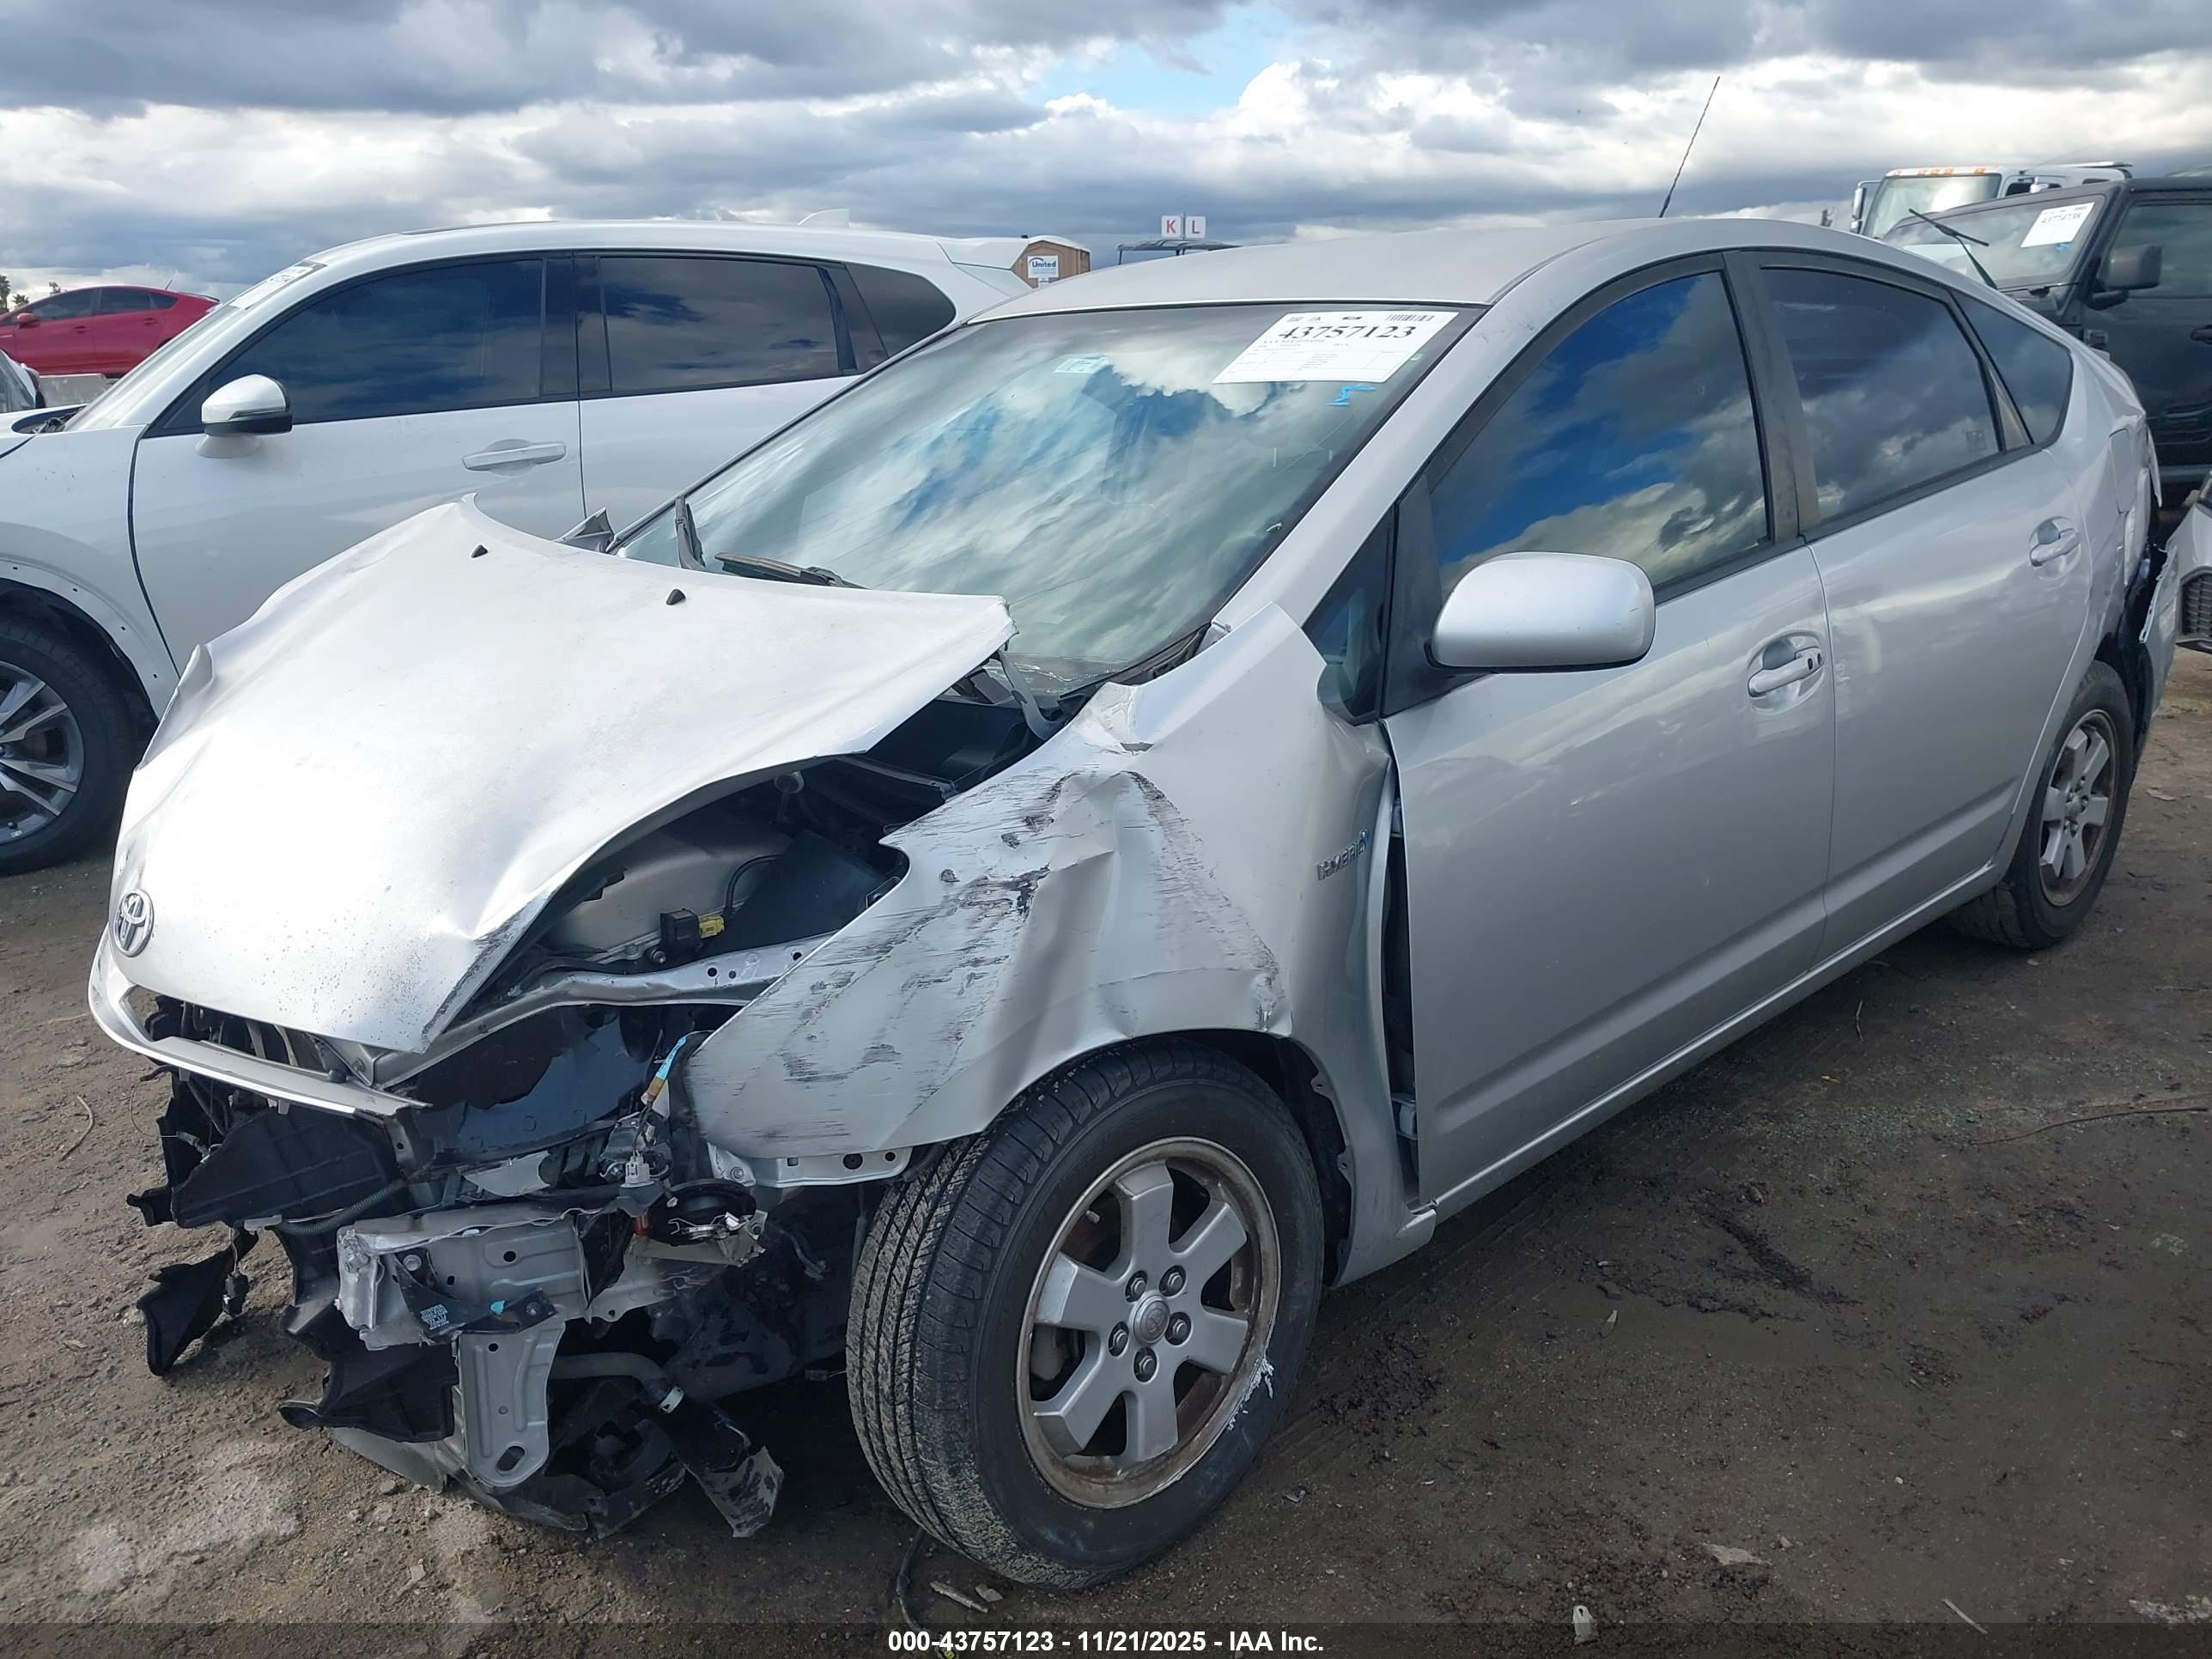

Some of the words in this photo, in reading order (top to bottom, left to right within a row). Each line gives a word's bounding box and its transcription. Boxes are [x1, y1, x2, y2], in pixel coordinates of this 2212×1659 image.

[1166, 220, 1176, 234] K
[1192, 220, 1200, 234] L
[1278, 325, 1417, 339] 43757123
